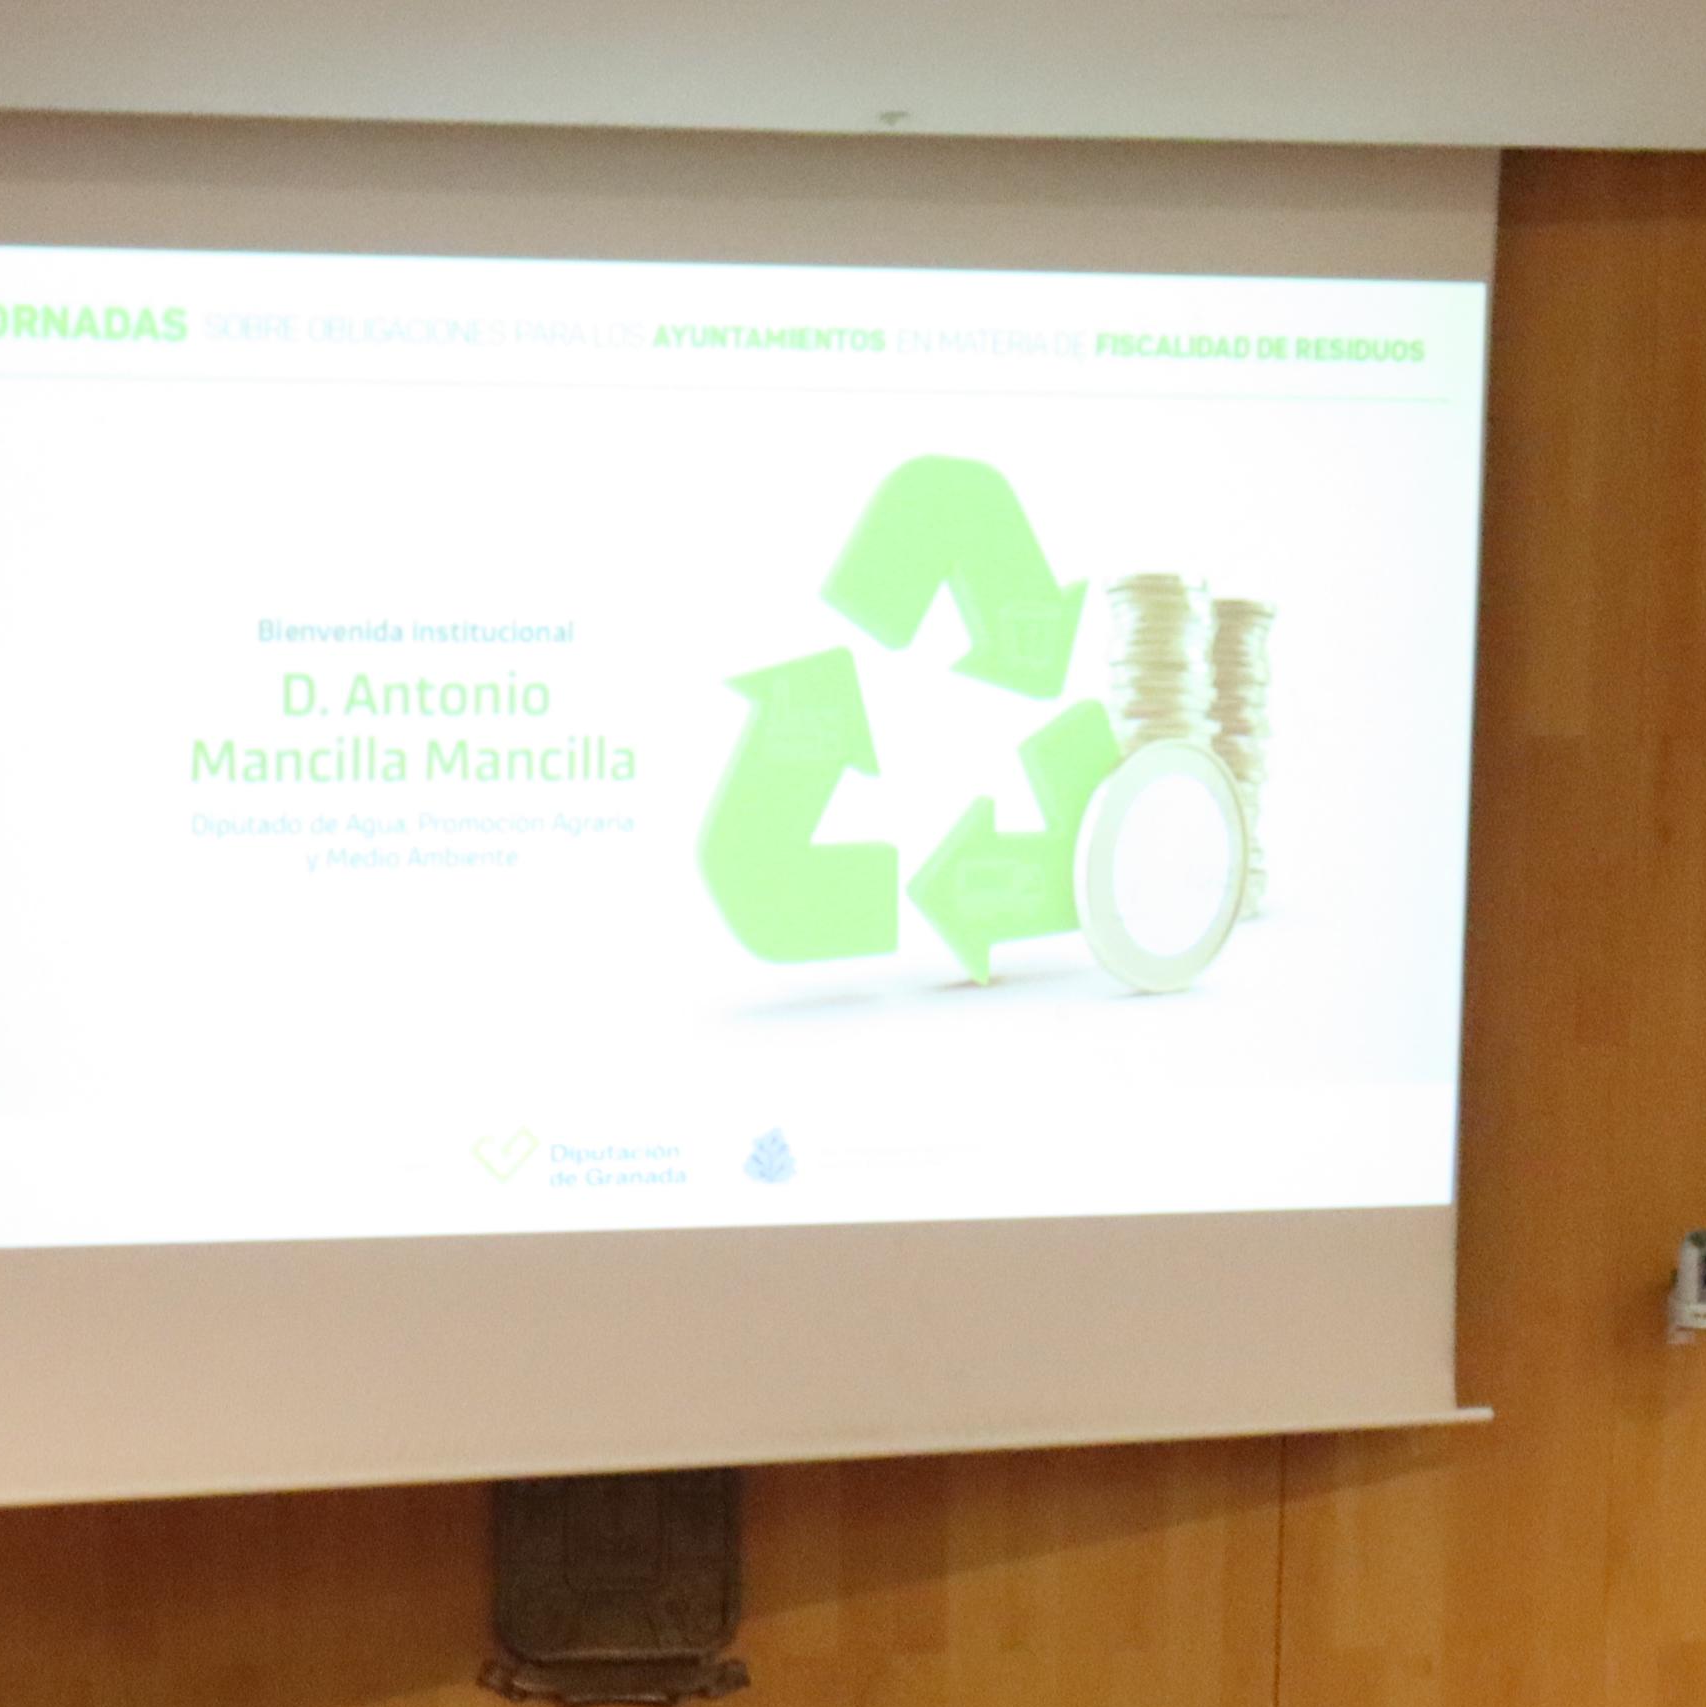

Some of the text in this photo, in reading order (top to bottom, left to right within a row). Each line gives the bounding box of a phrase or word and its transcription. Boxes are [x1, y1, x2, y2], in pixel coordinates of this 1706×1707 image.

[203, 312, 298, 342] SOBRE
[308, 313, 505, 346] OBLIGACIONES
[515, 319, 587, 347] PARA
[594, 321, 645, 350] LOS
[652, 323, 886, 353] AYUNTAMIENTOS
[897, 328, 934, 354] EN
[939, 328, 1048, 356] MATERIA
[1051, 331, 1085, 357] DE
[1096, 333, 1250, 360] FISCALIDAD
[1257, 337, 1289, 361] DE
[1296, 337, 1426, 363] RESIDUOS
[257, 619, 575, 644] Bienvenida institucional
[283, 669, 551, 717] D. Antonio
[190, 735, 637, 783] Mancilla Mancilla
[192, 813, 303, 839] Diputado
[311, 813, 339, 835] de
[552, 812, 635, 838] Agraria
[306, 846, 519, 873] y Medio Ambiente
[550, 1141, 682, 1165] Diputación
[550, 1167, 687, 1188] de Granada
